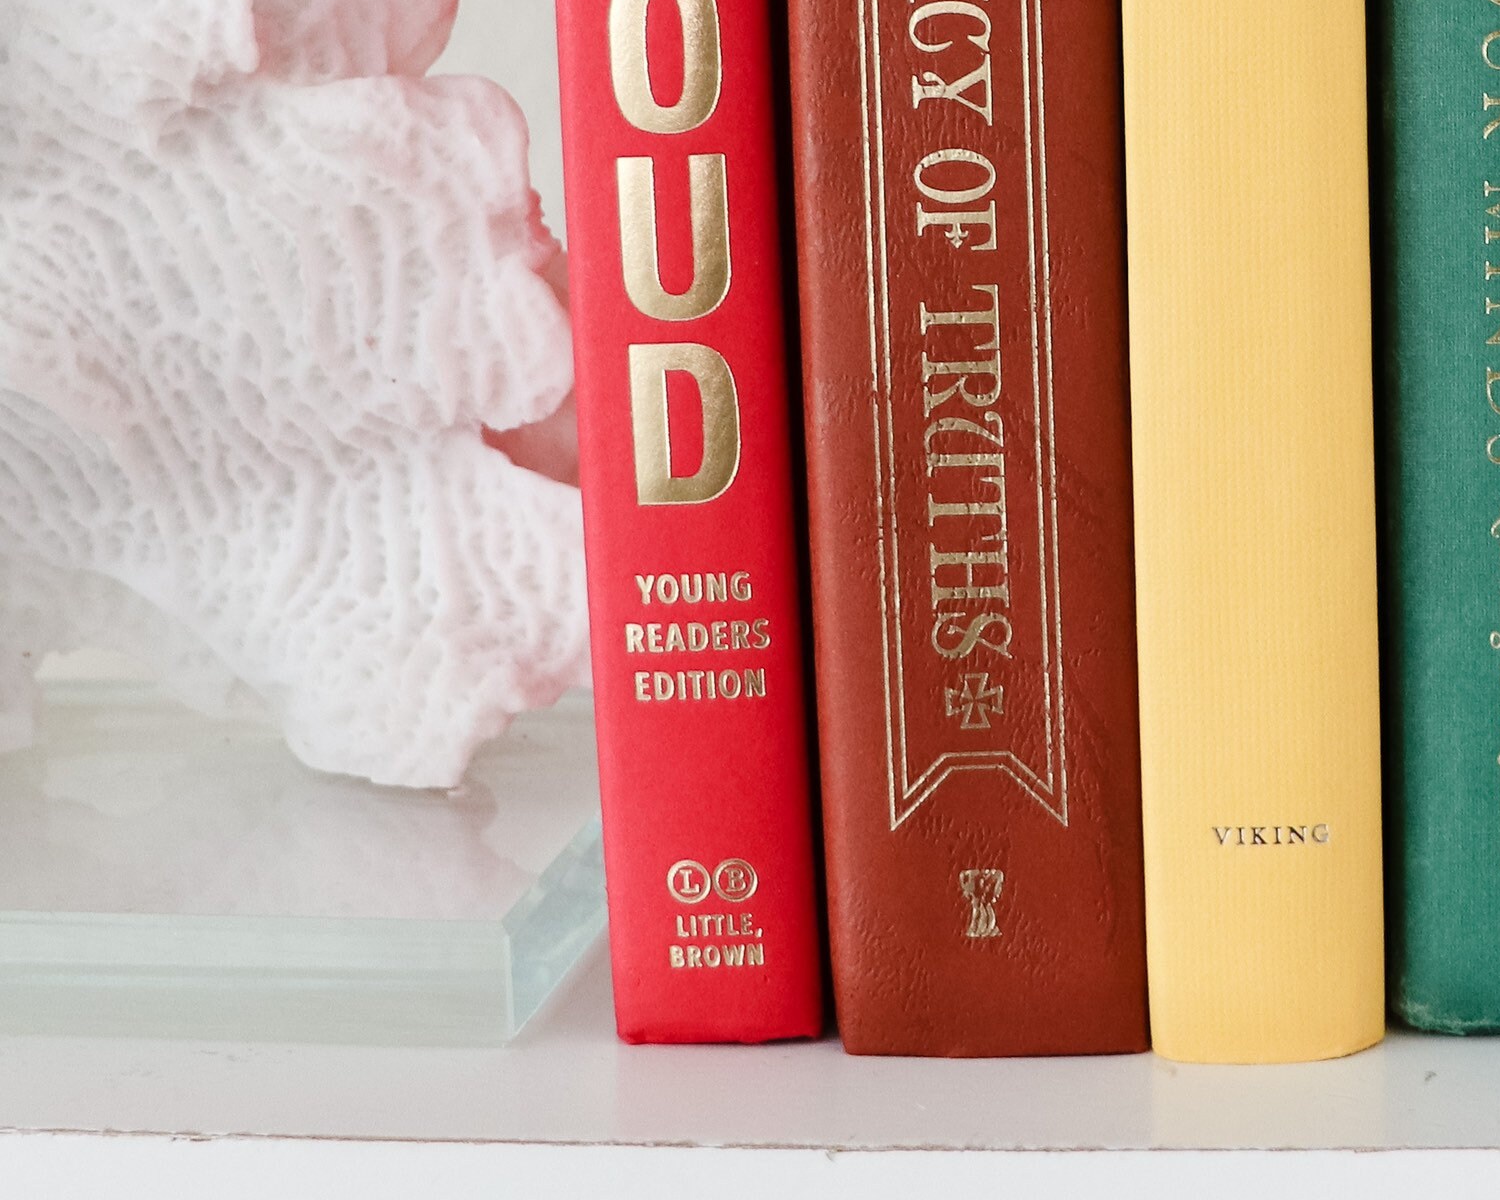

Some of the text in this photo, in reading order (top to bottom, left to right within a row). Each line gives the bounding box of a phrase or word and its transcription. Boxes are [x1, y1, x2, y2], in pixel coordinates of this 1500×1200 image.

[913, 147, 998, 252] OF
[919, 283, 1013, 659] TRUTHS
[634, 571, 753, 604] YOUNG
[624, 618, 772, 654] READERS
[634, 667, 768, 702] EDITION
[1211, 823, 1330, 847] VIKING
[675, 913, 763, 938] LITTLE,
[669, 943, 764, 968] BROWN
